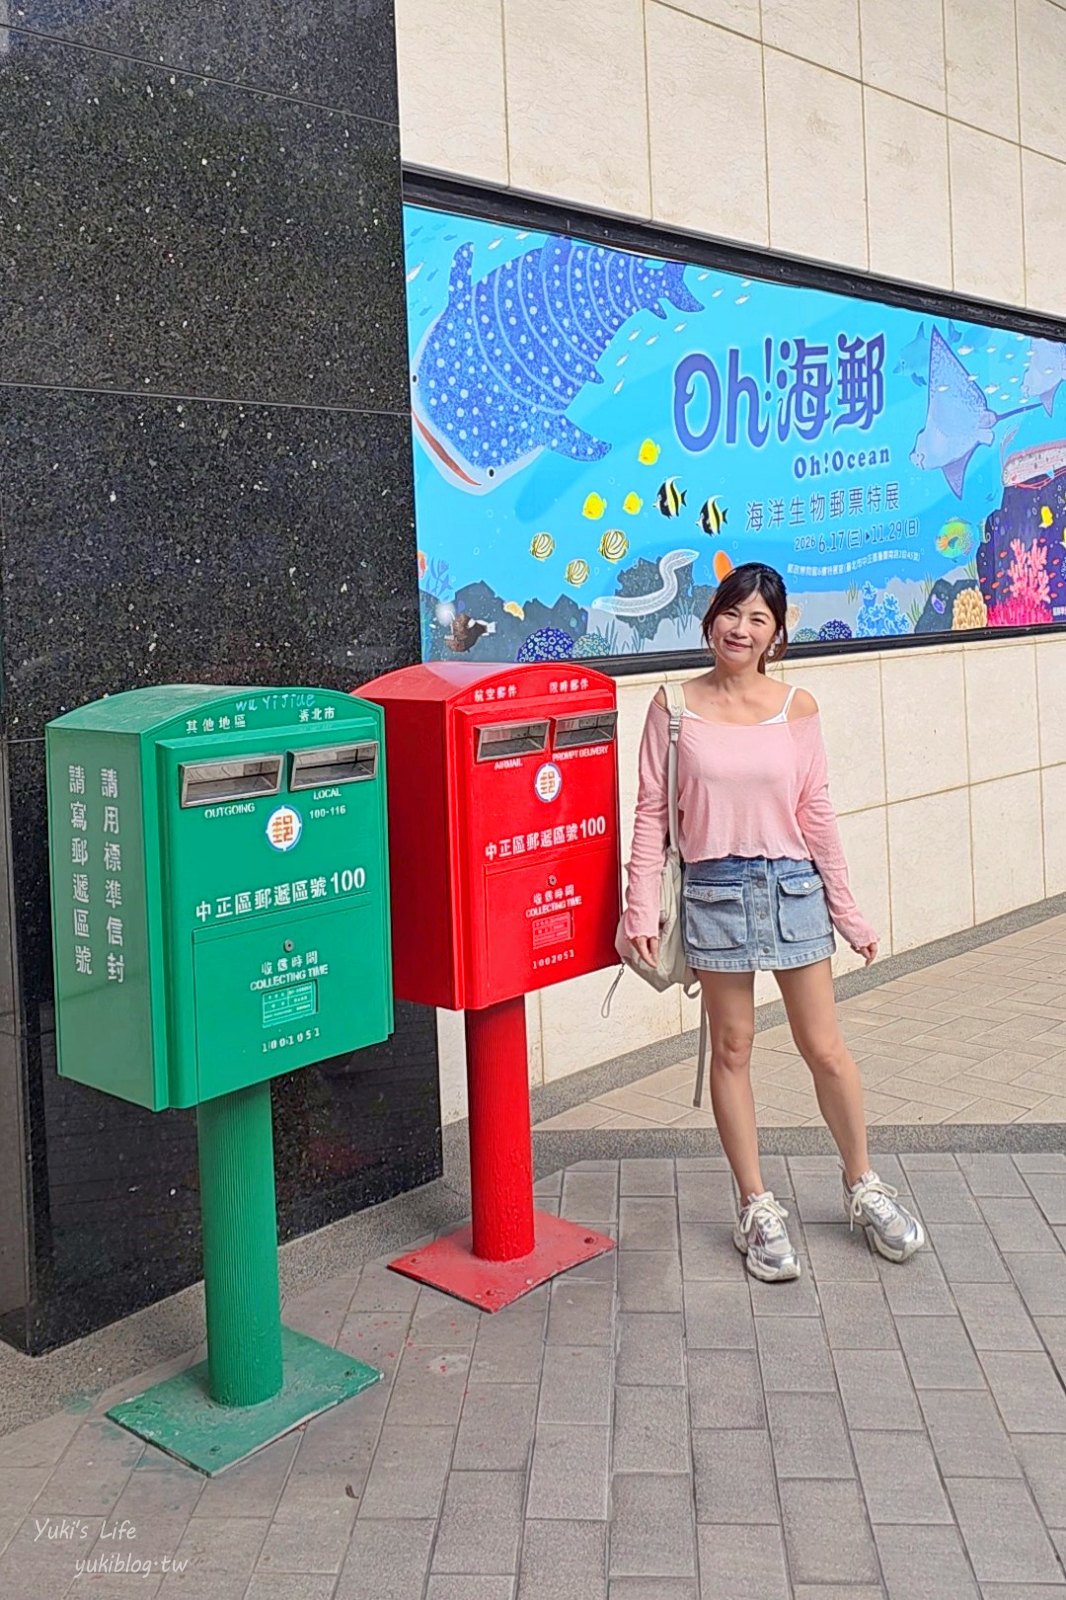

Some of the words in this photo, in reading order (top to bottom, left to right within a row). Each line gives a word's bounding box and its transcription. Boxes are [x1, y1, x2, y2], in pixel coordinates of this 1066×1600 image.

[745, 482, 899, 532] 海洋生物郵票特展
[795, 537, 816, 551] 2026
[186, 714, 246, 734] 其他地區
[552, 750, 579, 762] PROMPT
[579, 746, 609, 759] DELIVERY
[313, 788, 341, 801] LOCAL
[204, 803, 256, 819] OUTGOING
[309, 805, 346, 819] 100-116
[69, 765, 92, 975] 請寫郵遞區號
[100, 768, 125, 983] 請用標準信封
[526, 900, 567, 918] COLLECTING
[567, 896, 583, 907] TIME
[250, 970, 306, 991] COLLECTING
[308, 964, 328, 978] TIME
